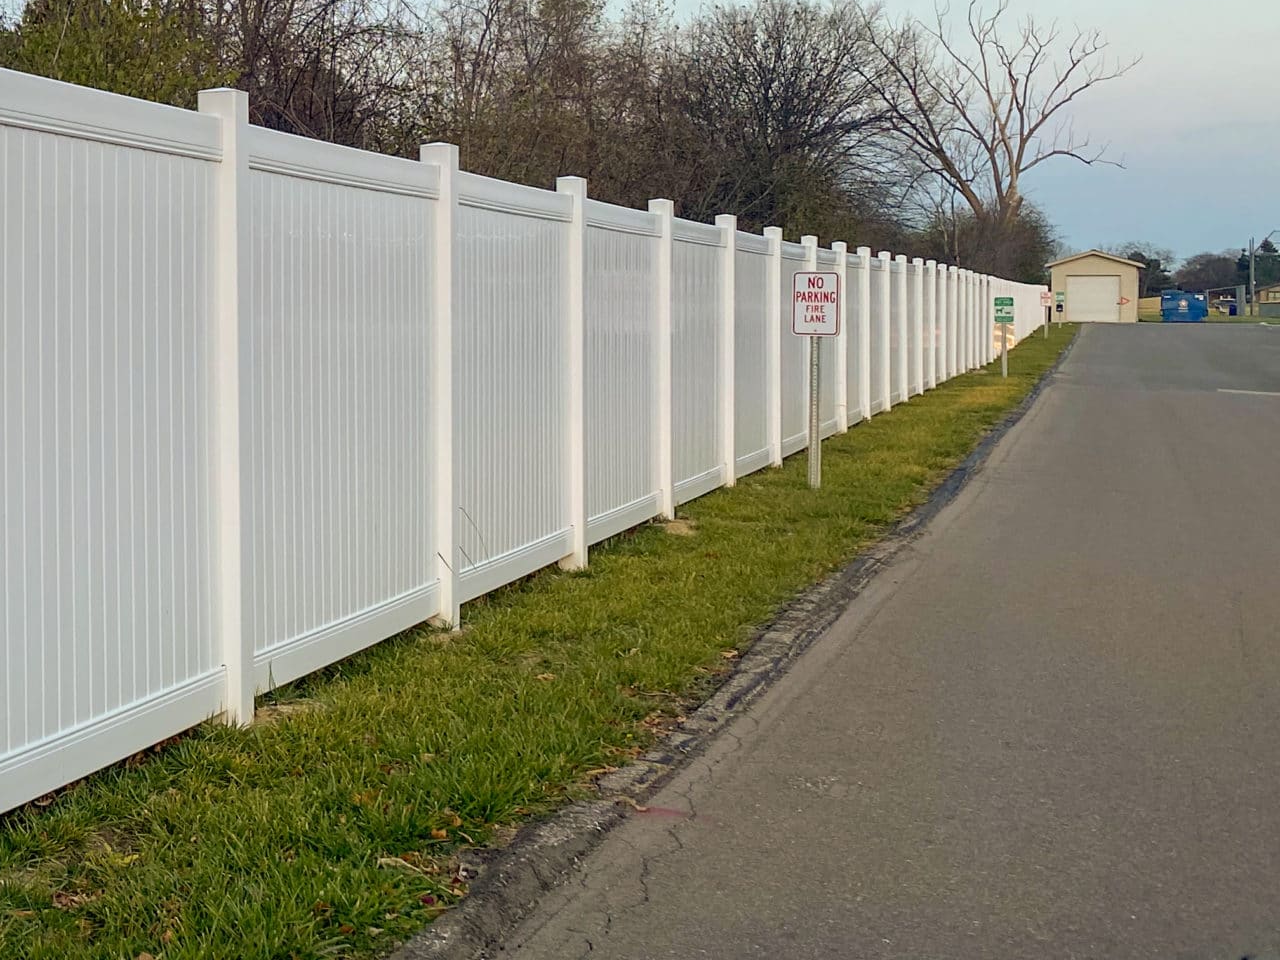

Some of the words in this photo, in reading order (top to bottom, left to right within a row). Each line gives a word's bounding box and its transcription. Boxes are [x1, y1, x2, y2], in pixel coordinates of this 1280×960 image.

[808, 277, 824, 289] NO
[796, 291, 836, 303] PARKING
[806, 305, 825, 313] FIRE
[804, 315, 826, 323] LANE
